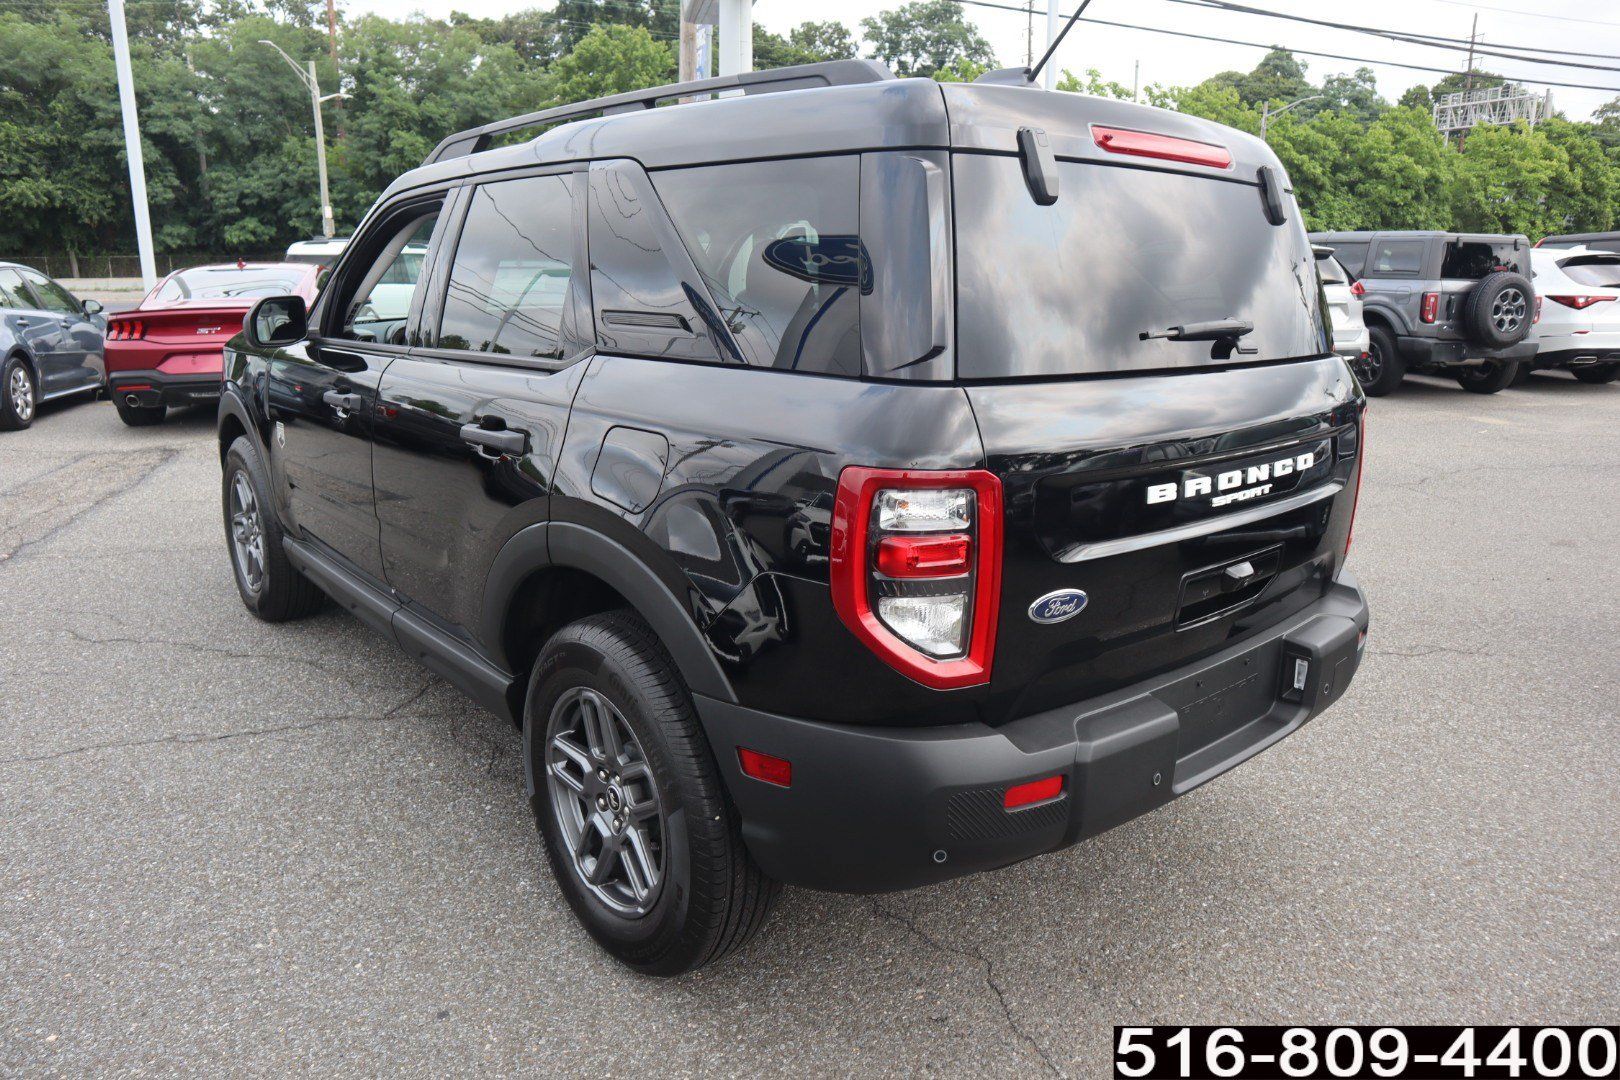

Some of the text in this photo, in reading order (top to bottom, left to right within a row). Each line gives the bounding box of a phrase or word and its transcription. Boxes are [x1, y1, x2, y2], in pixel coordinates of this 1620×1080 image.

[1147, 452, 1314, 505] BRONCO
[1211, 483, 1273, 508] SPORT
[1044, 596, 1078, 618] Ford
